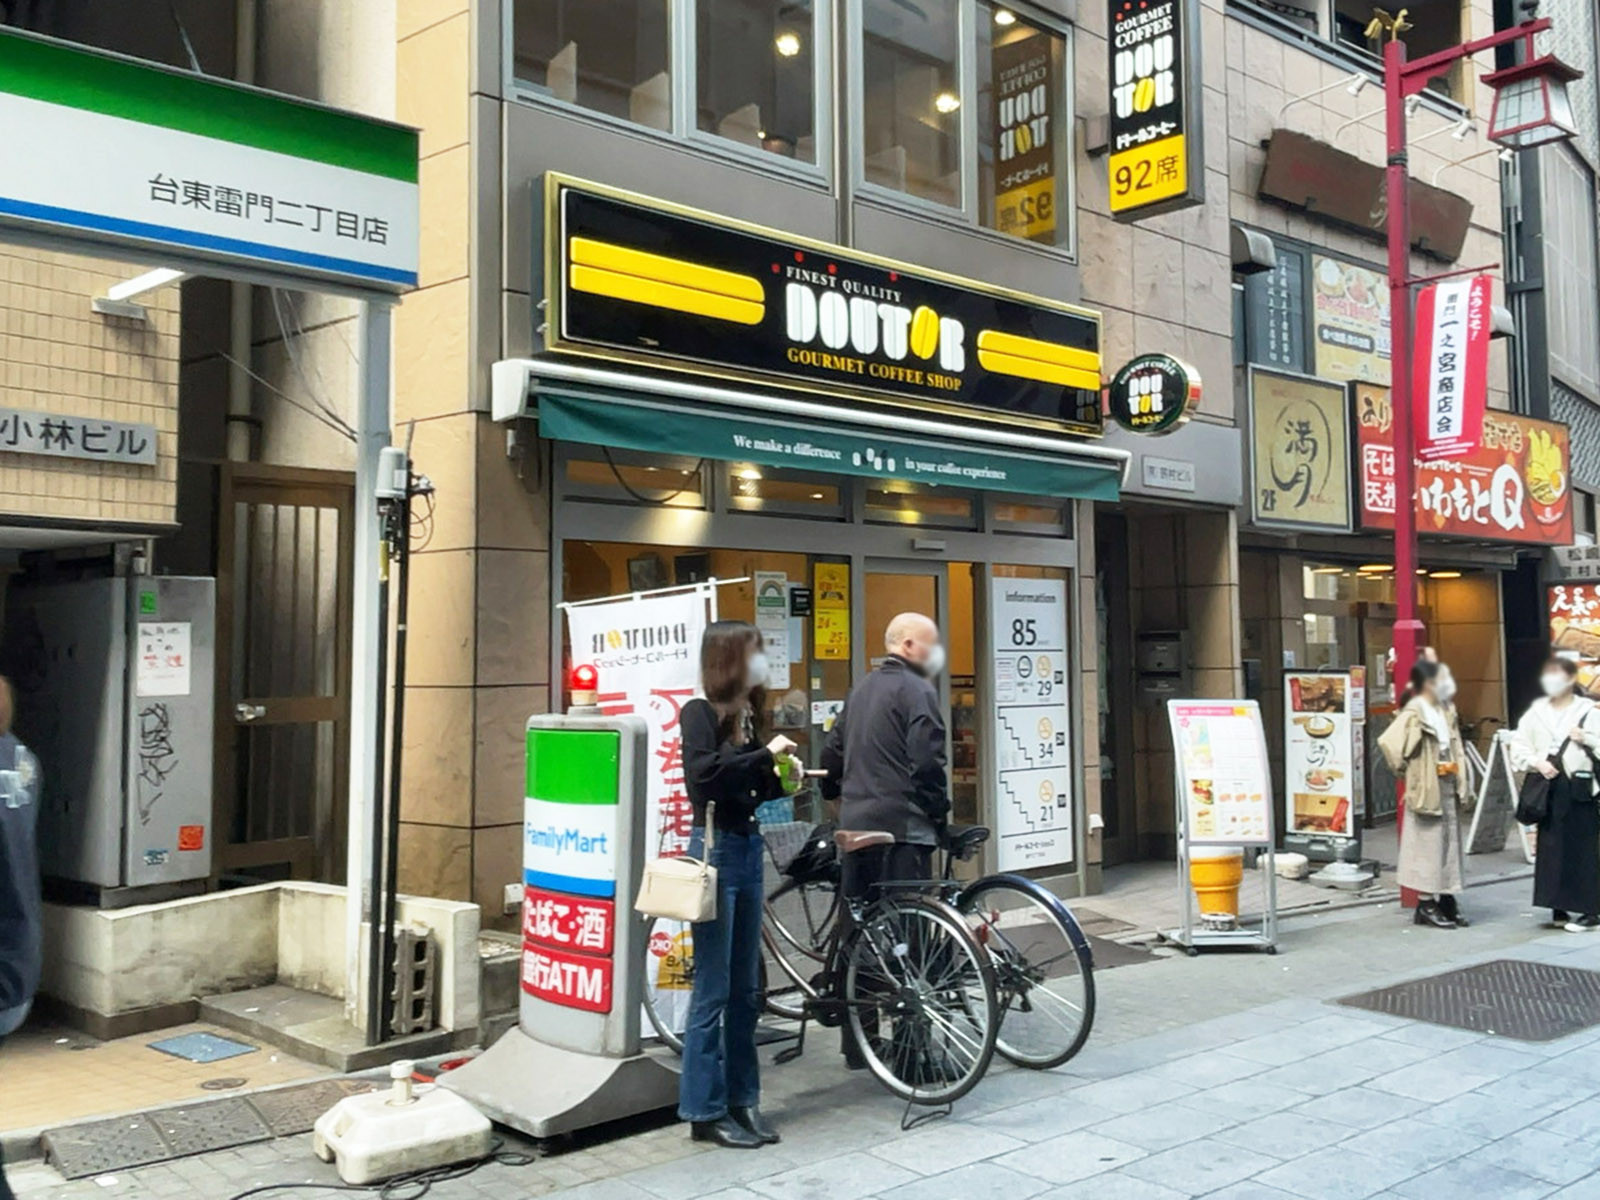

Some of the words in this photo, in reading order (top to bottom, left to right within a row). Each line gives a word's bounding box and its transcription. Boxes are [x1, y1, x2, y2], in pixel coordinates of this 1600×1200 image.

[1115, 2, 1173, 33] GOURMET
[1115, 15, 1173, 48] COFFEE
[1115, 154, 1179, 196] 92席
[148, 173, 390, 246] 台東雷門二丁目店
[786, 266, 837, 288] FINEST
[842, 279, 902, 302] QUALITY
[786, 282, 965, 372] DOUTOR
[787, 347, 865, 375] GOURMET
[868, 362, 925, 385] COFFEE
[926, 373, 962, 391] SHOP
[0, 413, 147, 457] 小林ビル
[733, 434, 752, 449] We
[754, 439, 783, 453] make
[784, 443, 792, 454] a
[792, 442, 841, 460] difference
[905, 457, 915, 469] in
[914, 460, 936, 474] your
[962, 466, 1007, 481] experience
[1012, 618, 1037, 646] 85
[1037, 681, 1052, 697] 29
[1039, 743, 1054, 759] 34
[1040, 806, 1054, 822] 21
[526, 822, 608, 856] FamilyMart
[522, 949, 603, 1004] 銀行ATM
